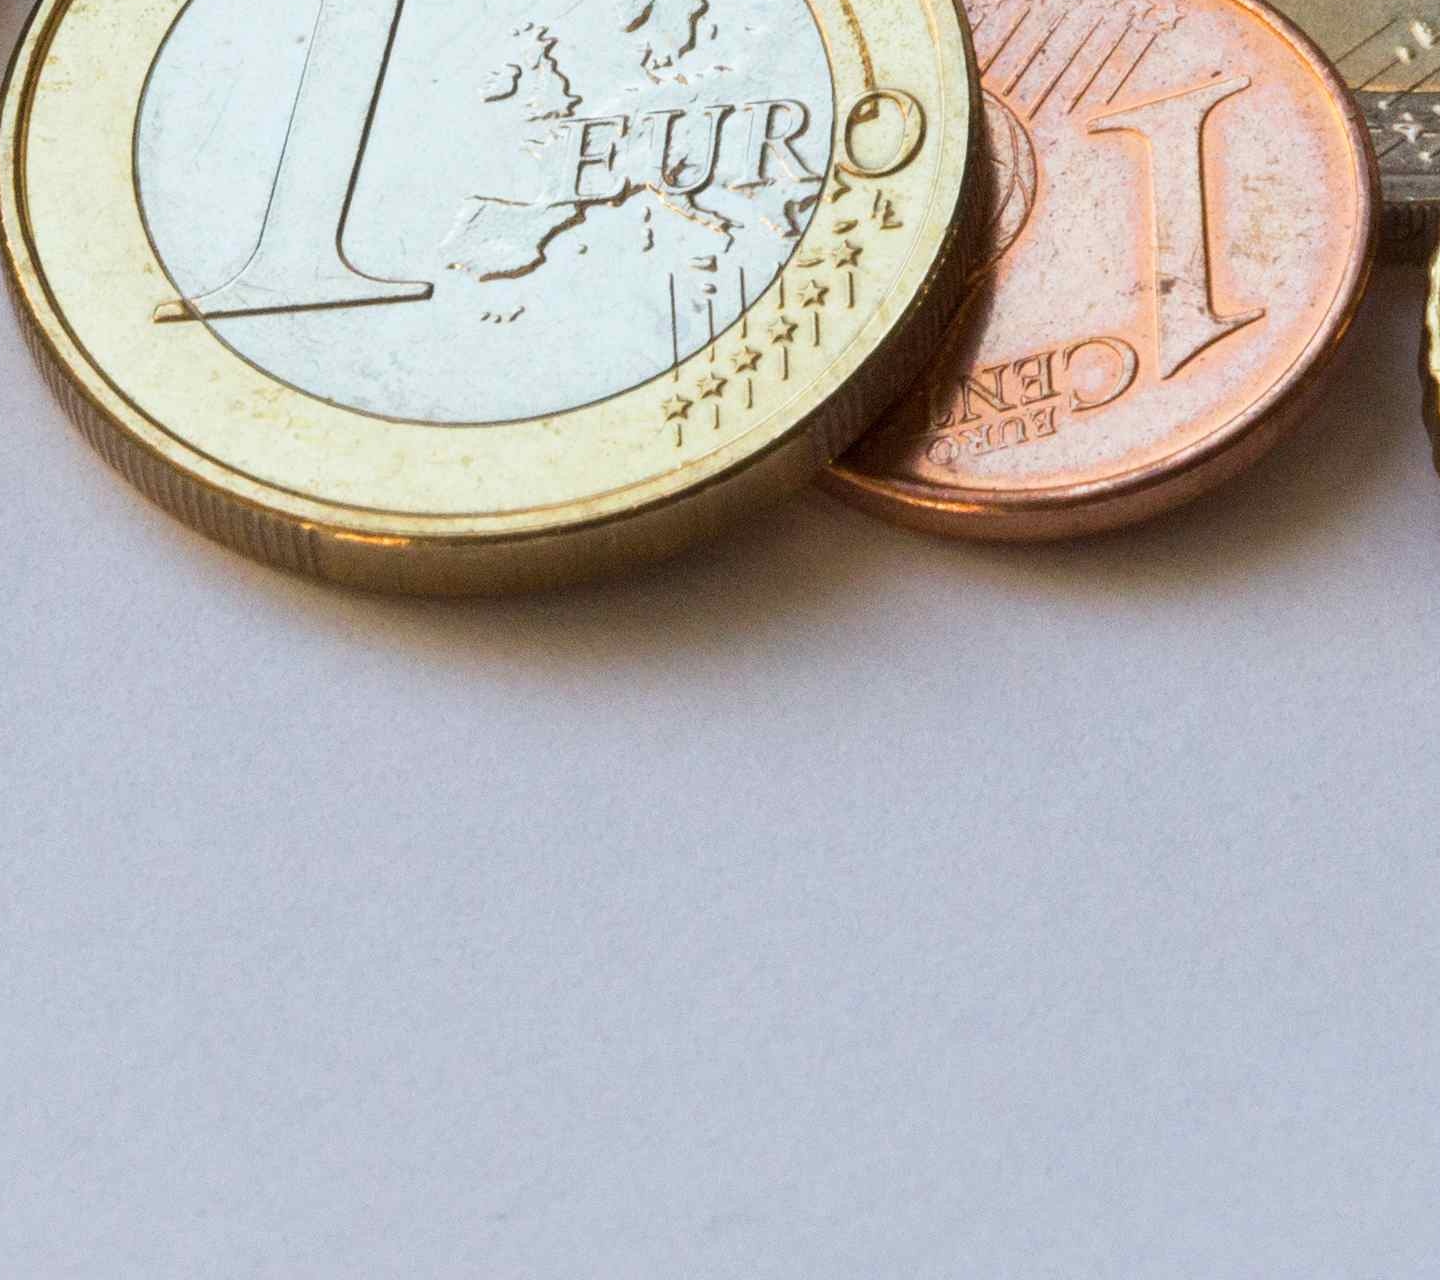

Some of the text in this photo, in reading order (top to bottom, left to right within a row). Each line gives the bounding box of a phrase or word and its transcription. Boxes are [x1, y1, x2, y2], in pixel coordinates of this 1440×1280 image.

[559, 87, 928, 208] EURO
[1087, 74, 1267, 381] 1
[926, 406, 1058, 466] EURO
